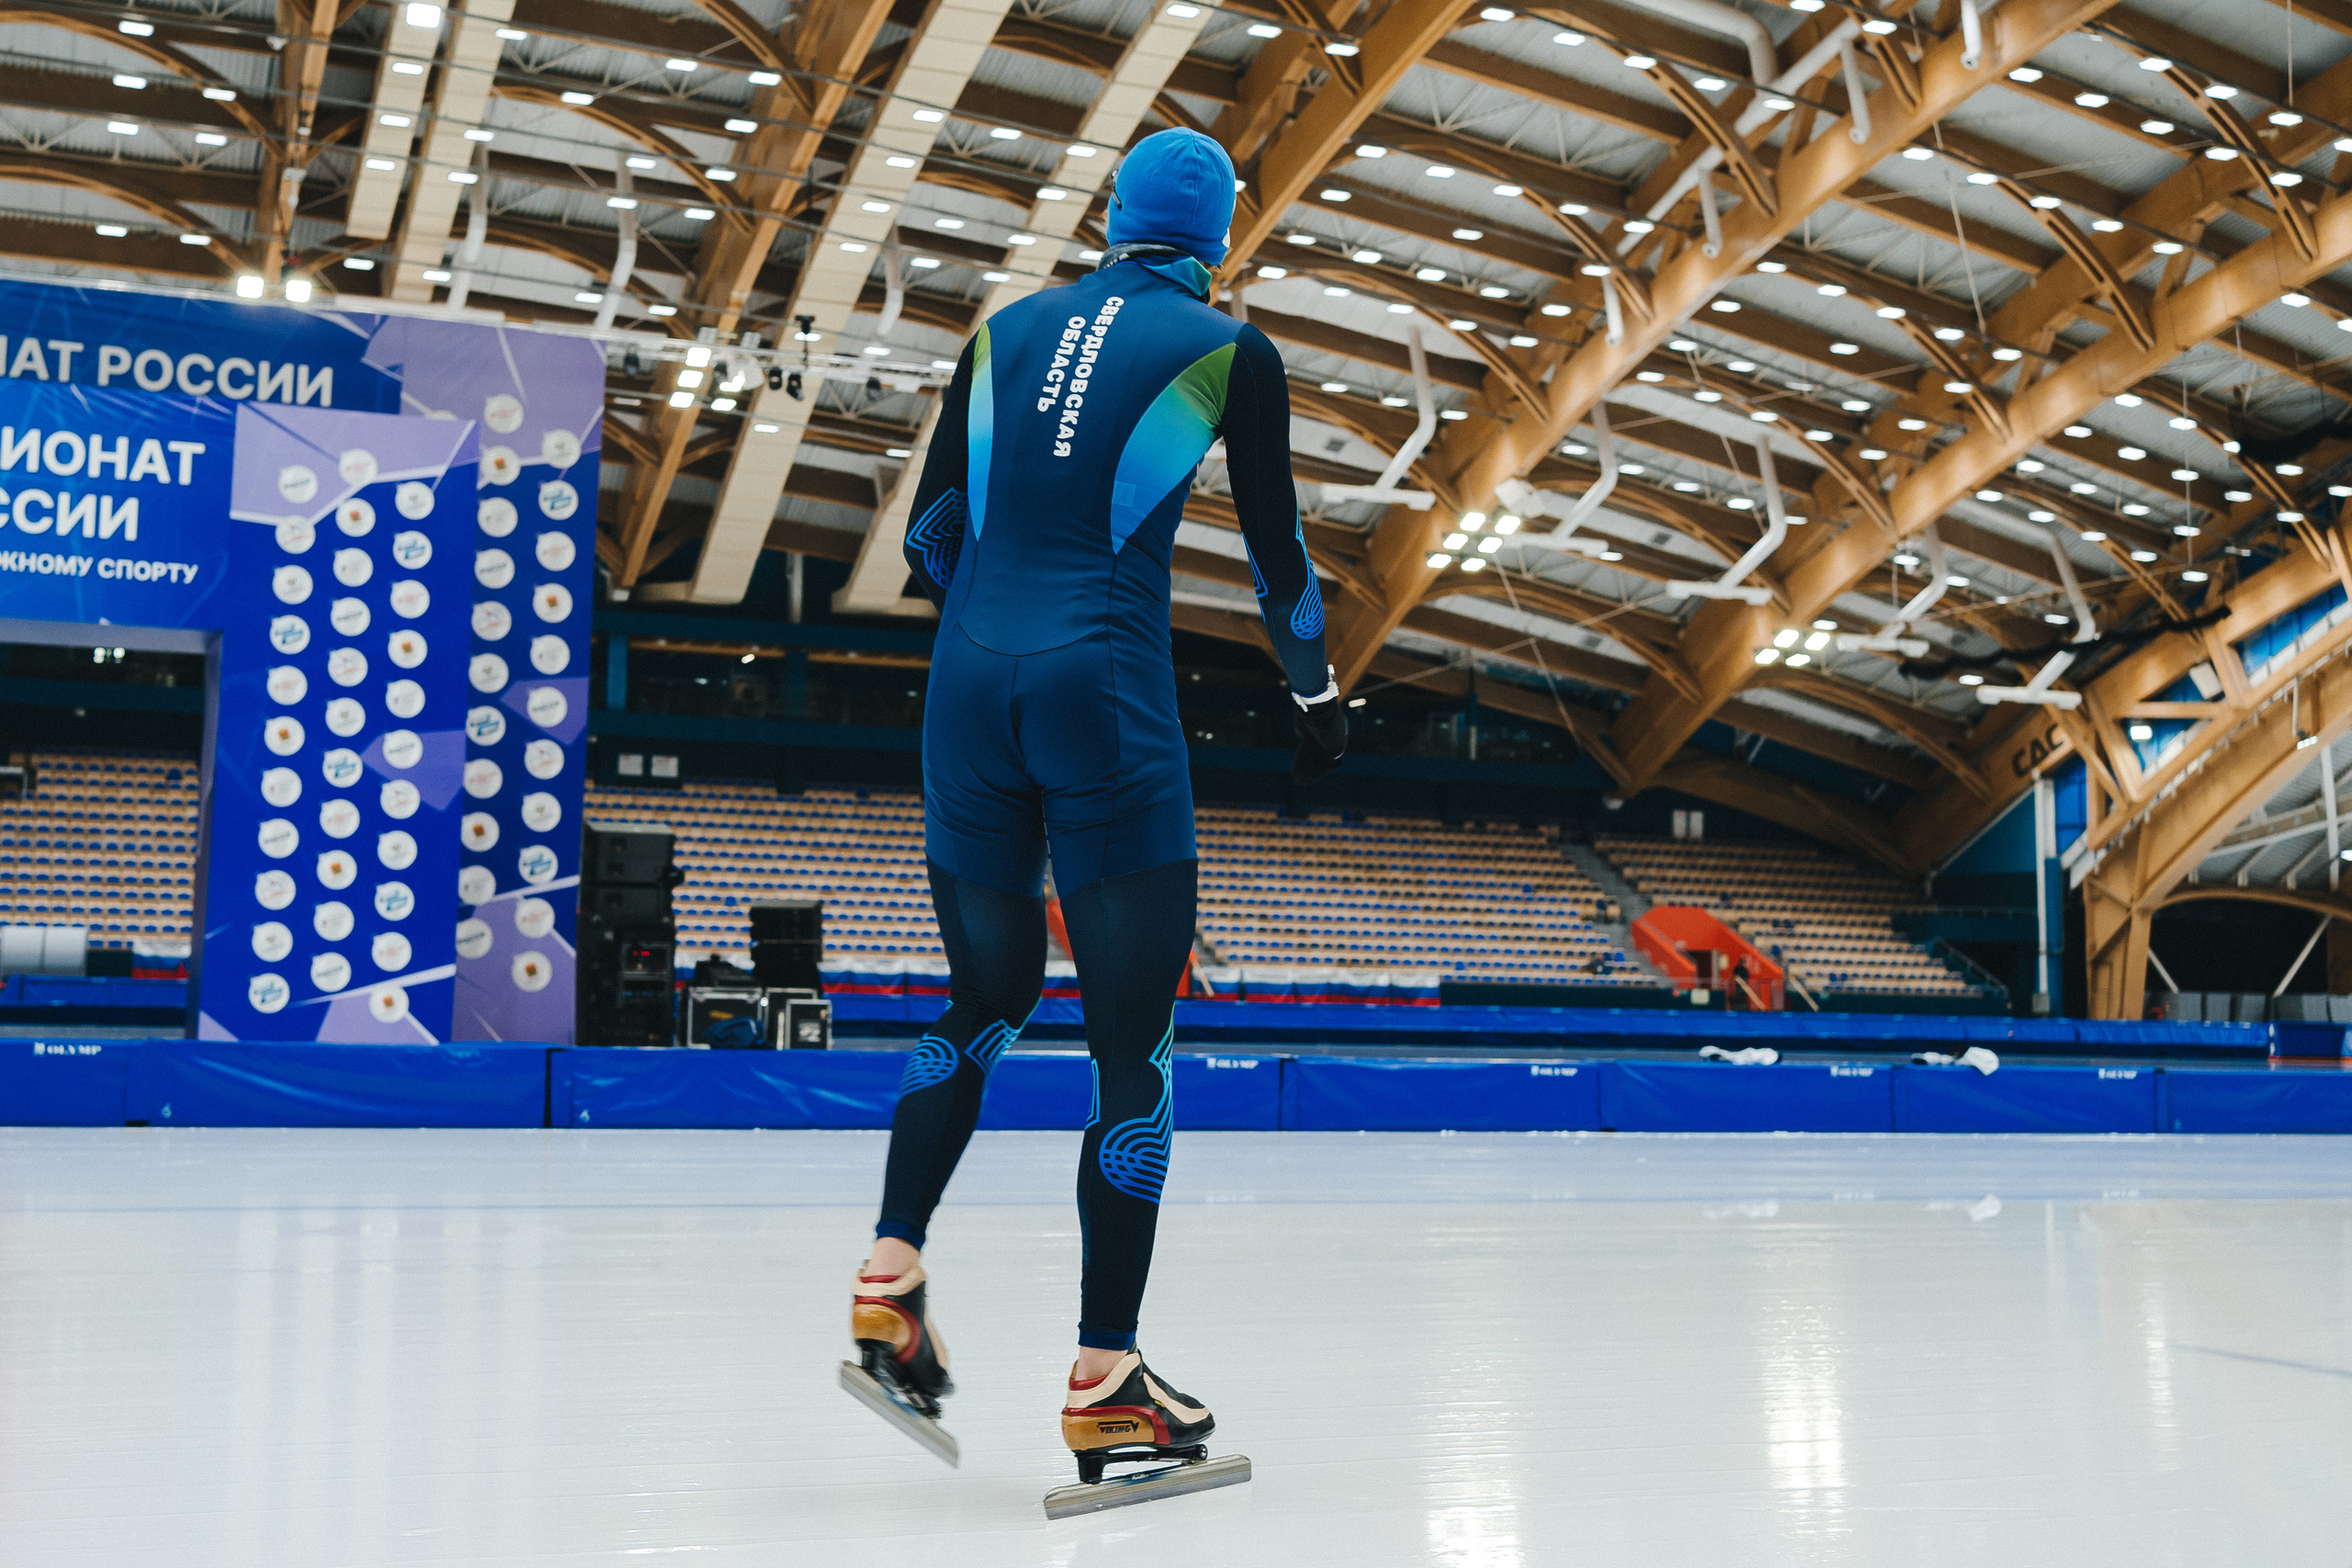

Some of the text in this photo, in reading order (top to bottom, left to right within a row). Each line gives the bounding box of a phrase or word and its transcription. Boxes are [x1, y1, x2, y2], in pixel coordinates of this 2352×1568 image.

[0, 334, 334, 408] АТ РОССИИ
[1037, 316, 1087, 412] ОБЛАСТЬ
[1053, 296, 1125, 457] СВЕРДЛОВСКАЯ
[1, 425, 206, 486] ИОНАТ
[0, 487, 139, 542] СИИ
[96, 558, 198, 585] СПОРТУ
[1097, 1422, 1139, 1434] VIKING
